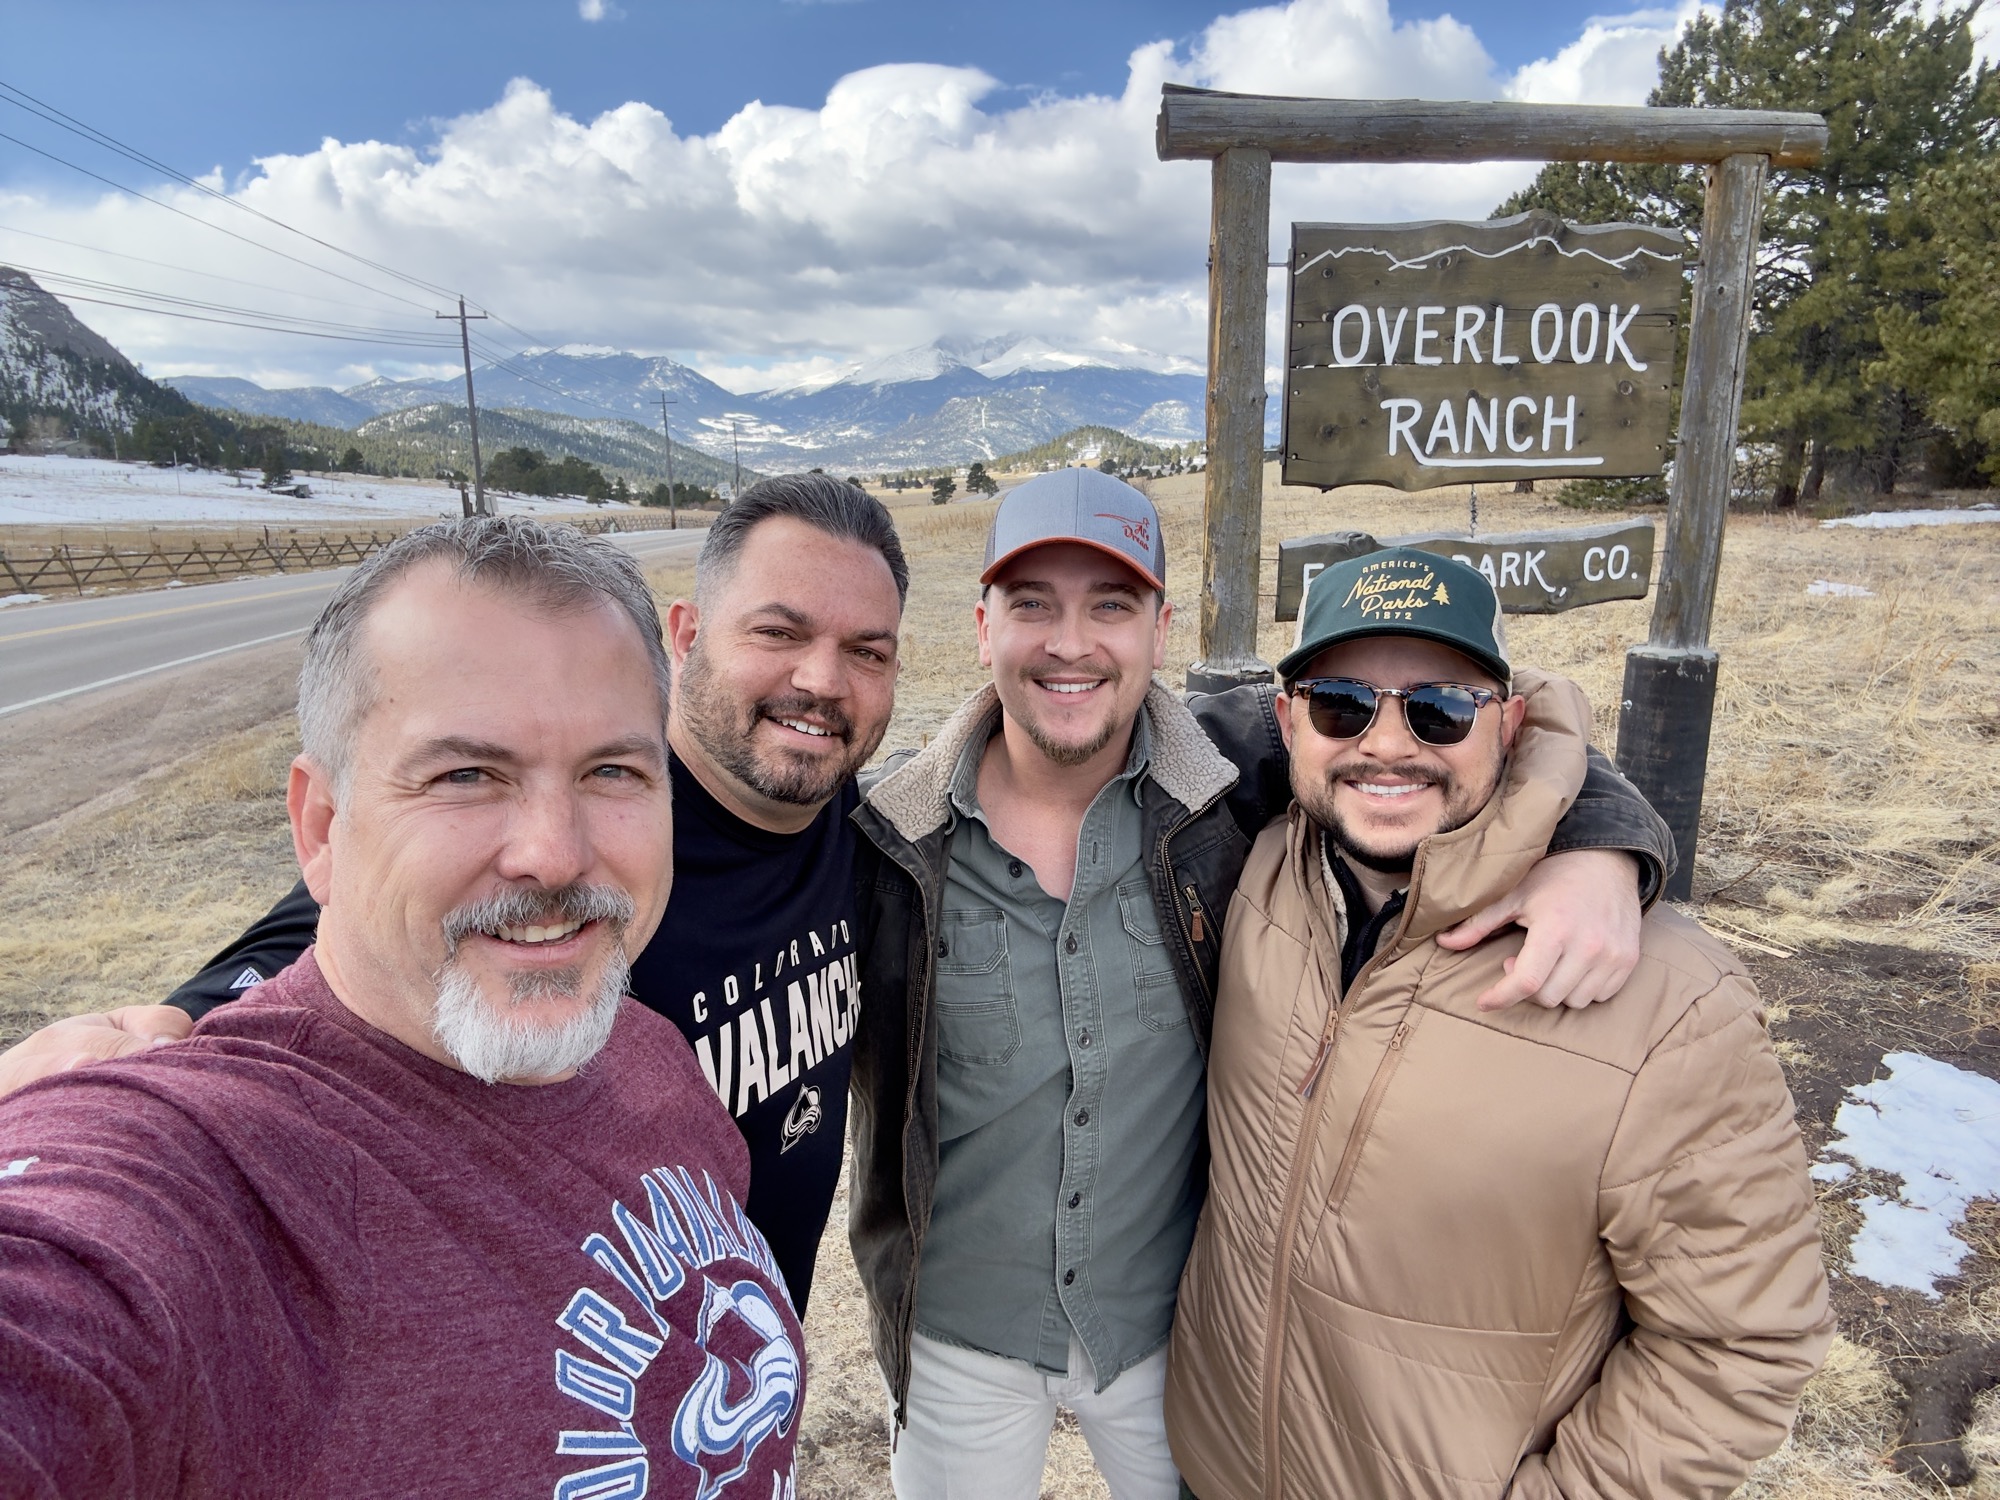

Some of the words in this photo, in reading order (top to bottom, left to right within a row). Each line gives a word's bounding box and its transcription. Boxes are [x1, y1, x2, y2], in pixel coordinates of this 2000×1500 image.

[1331, 303, 1648, 372] OVERLOOK
[1379, 395, 1605, 467] RANCH
[1362, 560, 1430, 574] AMERICA'S
[1582, 544, 1638, 582] CO.
[1341, 572, 1435, 609] National
[1360, 589, 1429, 618] Parks
[1375, 611, 1413, 621] 1872
